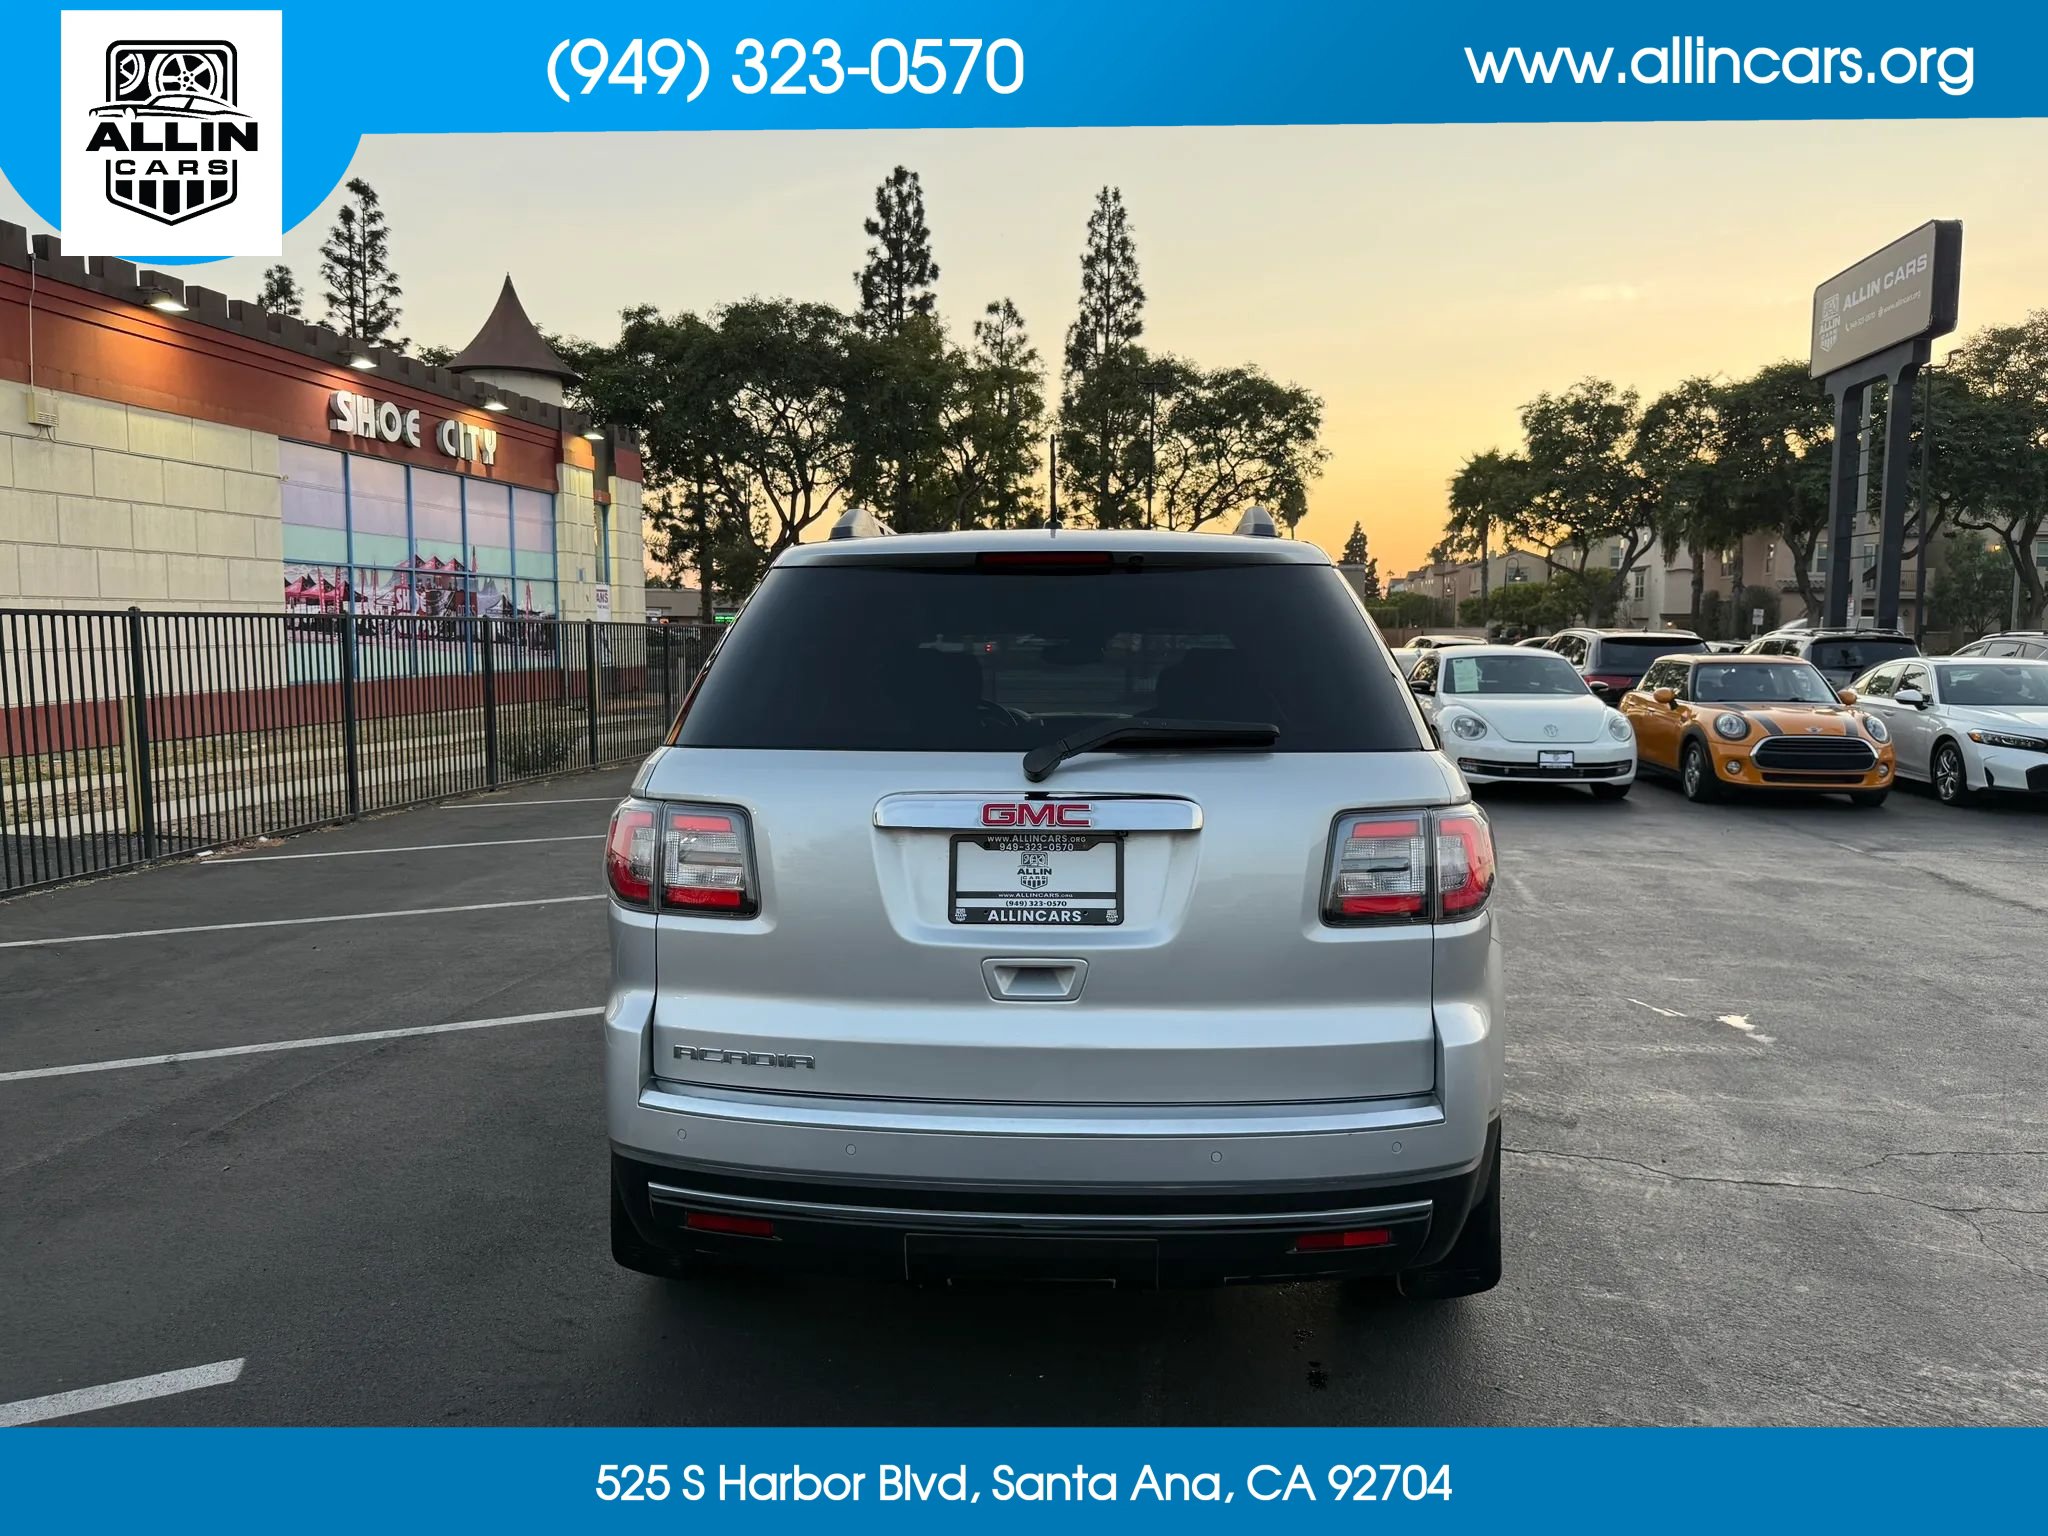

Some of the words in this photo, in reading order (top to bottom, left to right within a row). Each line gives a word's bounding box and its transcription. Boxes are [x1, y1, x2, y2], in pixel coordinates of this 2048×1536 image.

[1842, 277, 1881, 312] ALLIN
[1884, 253, 1928, 291] CARS
[330, 390, 421, 448] SHOE
[436, 420, 497, 466] CITY
[981, 803, 1092, 828] GMC
[999, 843, 1074, 851] 949-323-0570
[987, 909, 1083, 922] ALLINCARS
[673, 1044, 816, 1069] ACADIA
